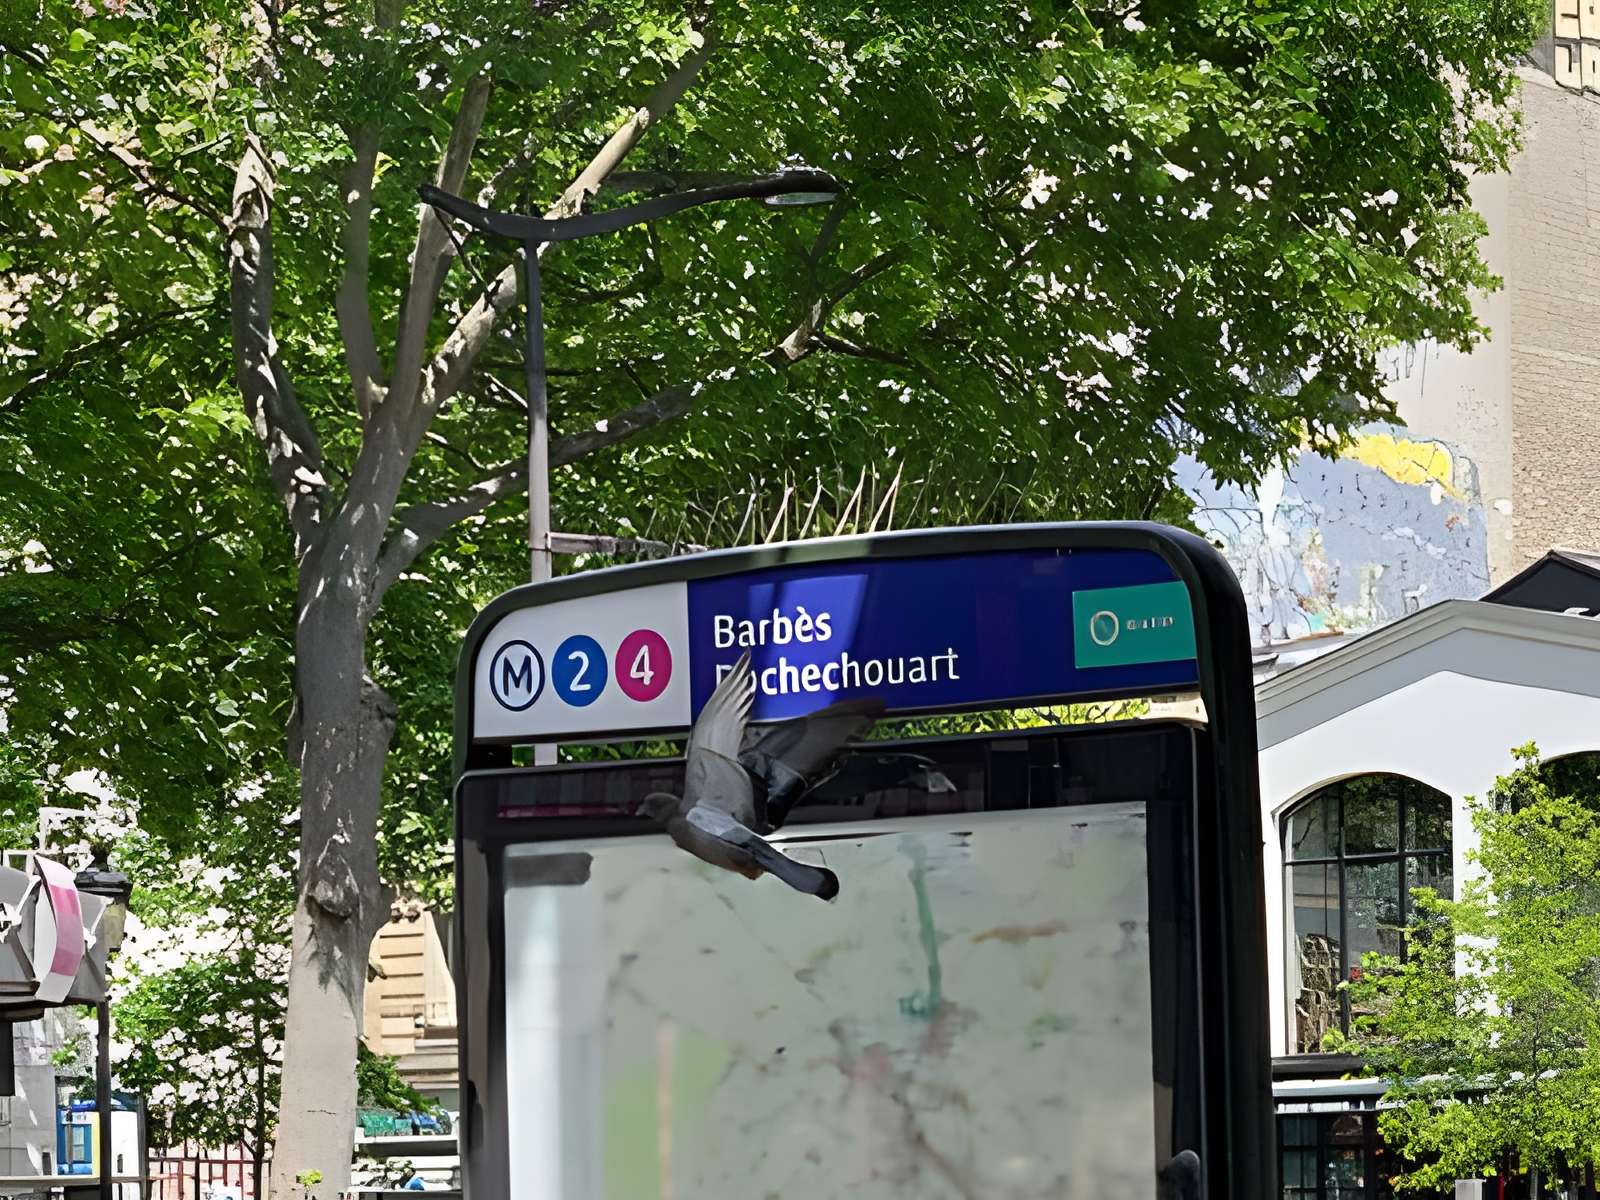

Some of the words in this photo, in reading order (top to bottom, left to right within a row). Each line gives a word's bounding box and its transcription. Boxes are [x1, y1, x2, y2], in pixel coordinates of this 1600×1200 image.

[714, 606, 832, 648] Barbès
[568, 650, 592, 692] 2
[630, 644, 655, 686] 4
